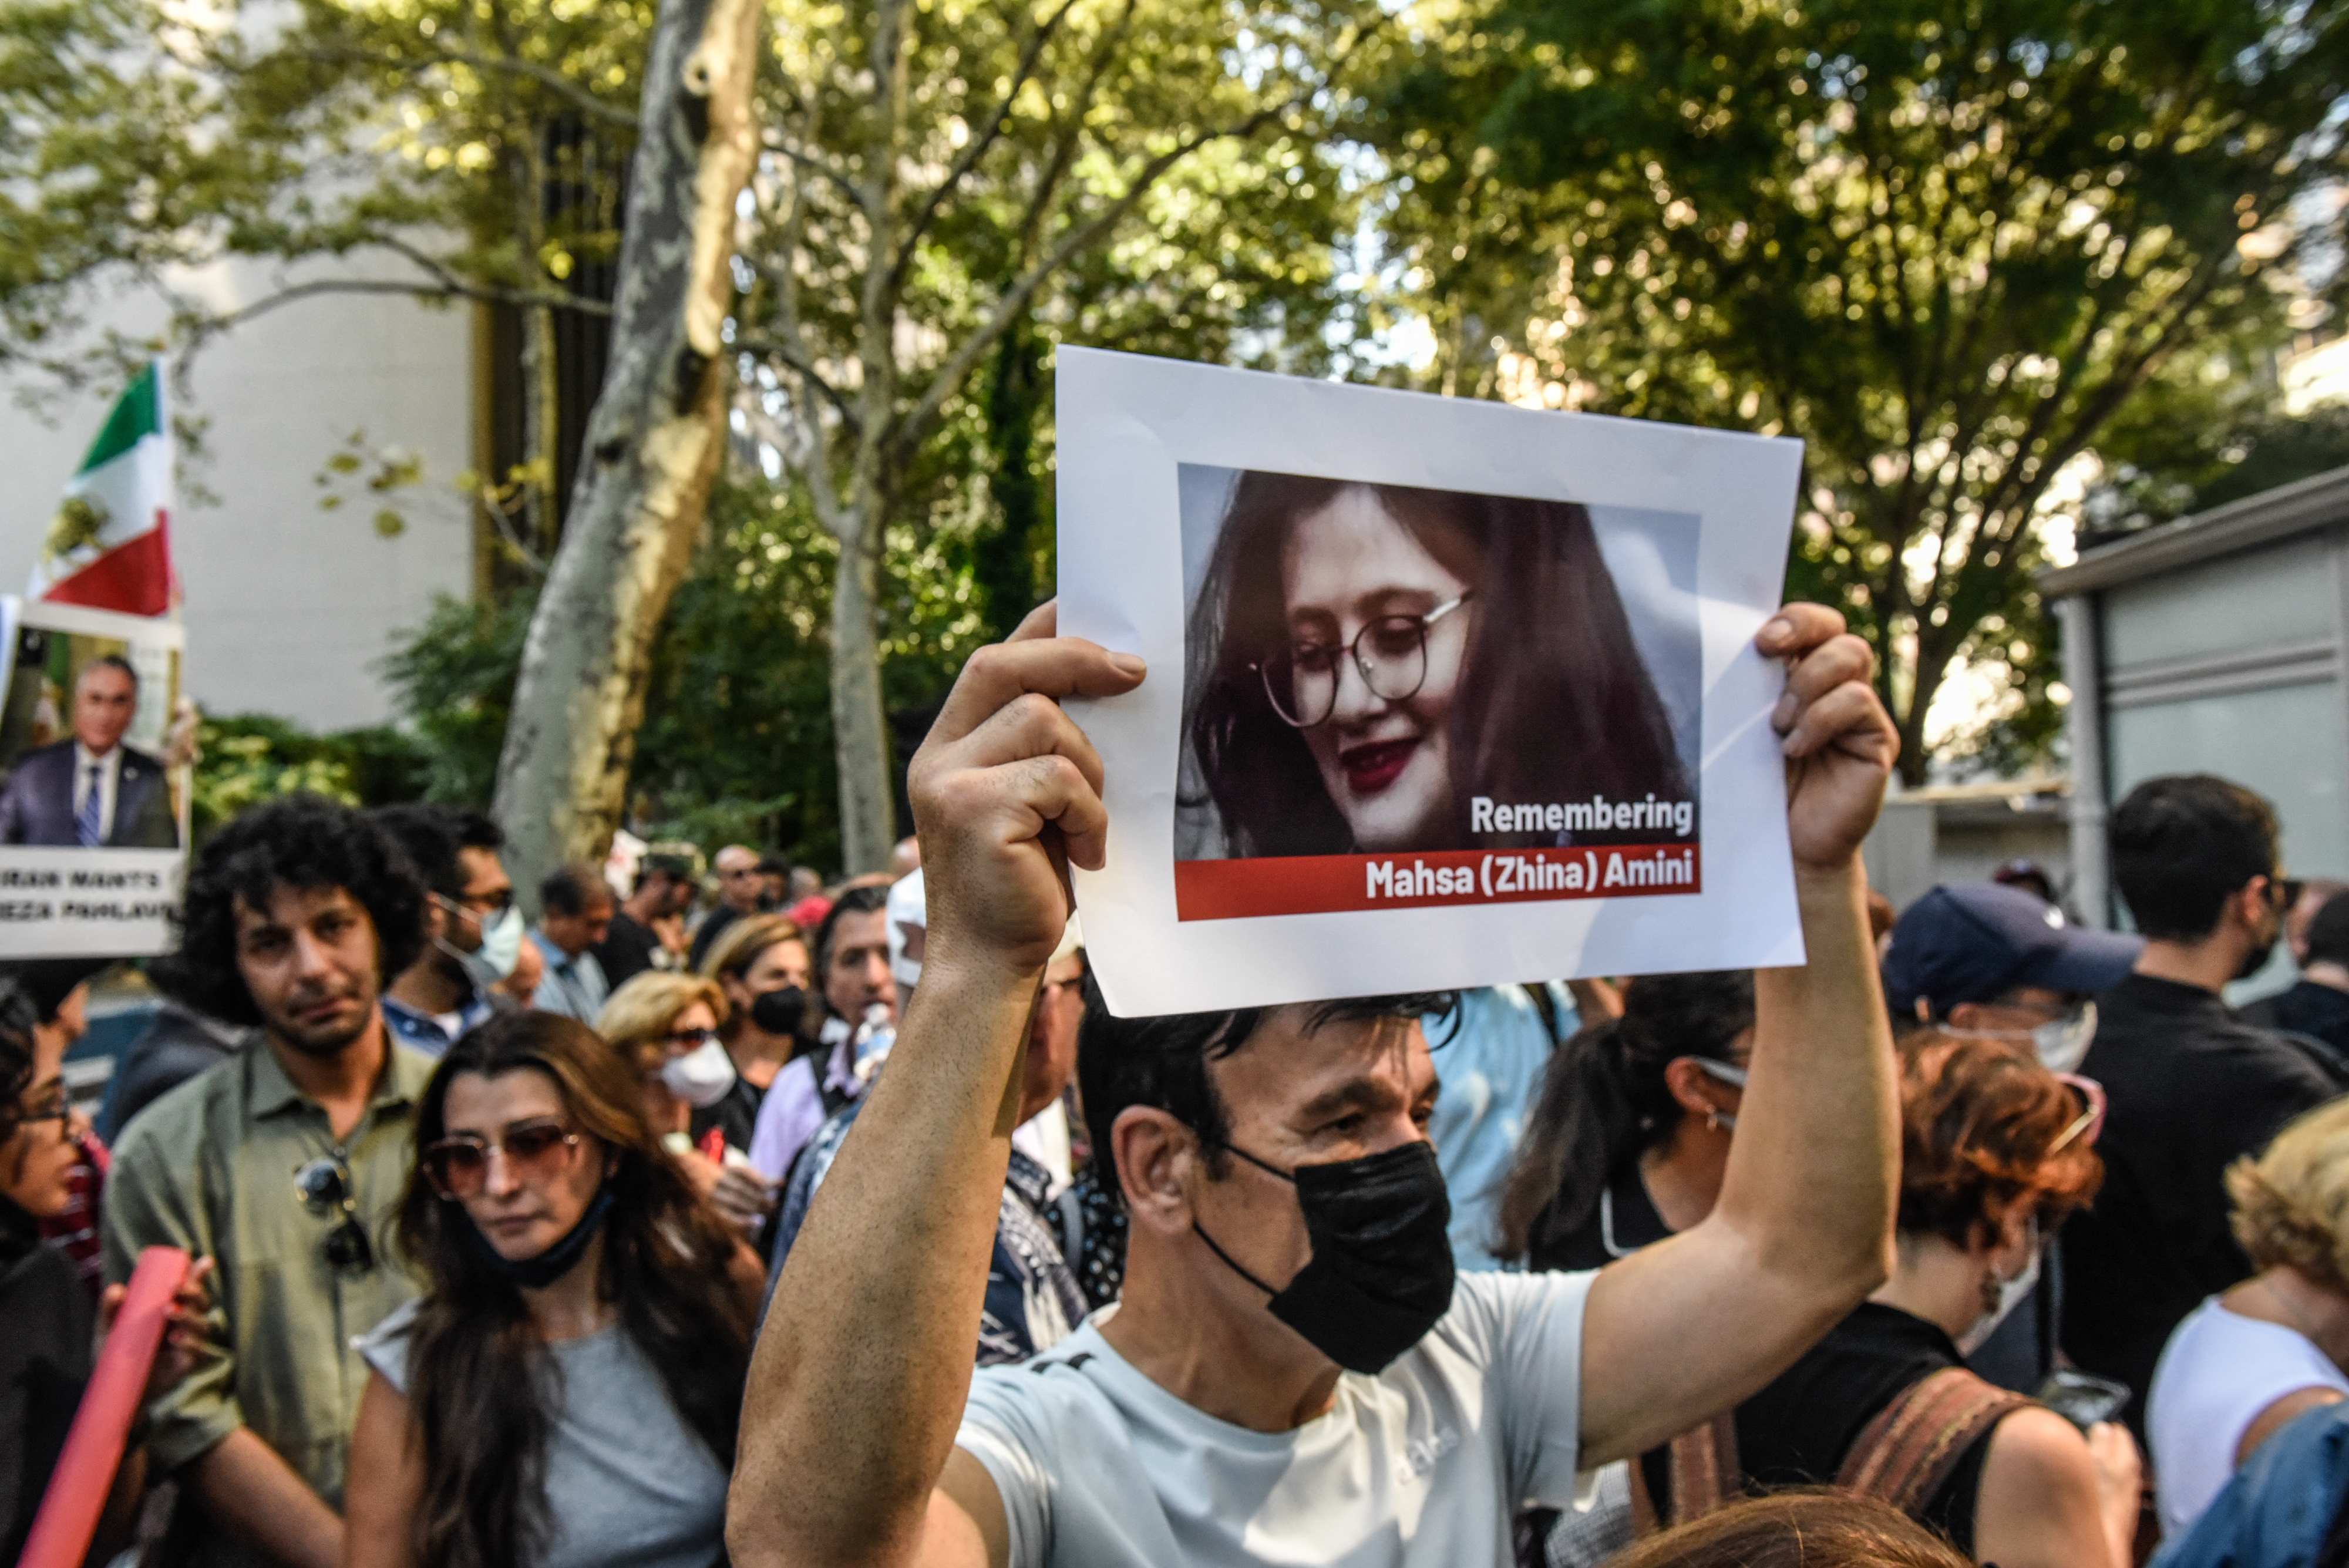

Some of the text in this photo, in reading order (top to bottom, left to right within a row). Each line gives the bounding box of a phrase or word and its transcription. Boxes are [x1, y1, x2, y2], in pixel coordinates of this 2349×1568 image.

[1471, 793, 1693, 836] Remembering
[69, 870, 159, 889] WANTS
[1366, 848, 1693, 899] Mahsa (Zhina) Amini
